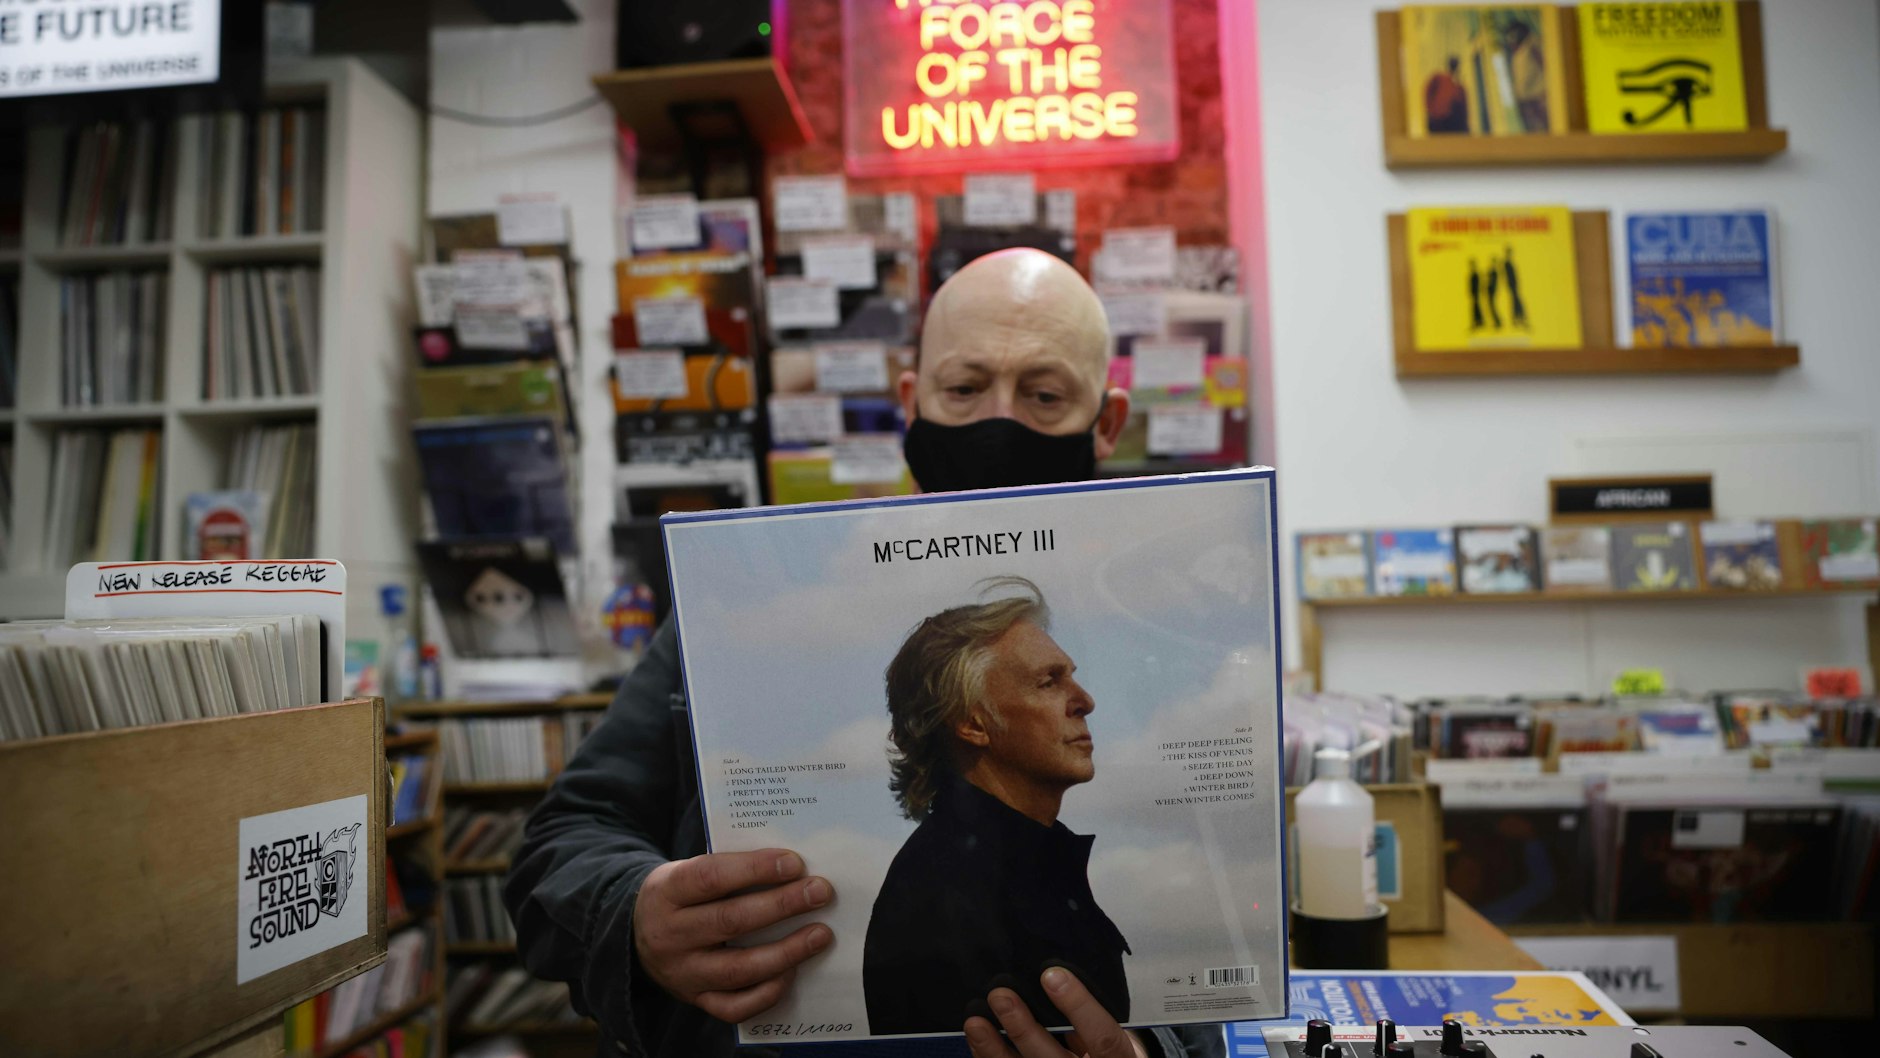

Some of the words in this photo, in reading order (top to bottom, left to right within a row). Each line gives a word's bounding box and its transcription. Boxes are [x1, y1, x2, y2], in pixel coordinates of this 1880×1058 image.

[1593, 2, 1722, 24] FREEDOM
[34, 2, 192, 43] FUTURE
[920, 0, 1095, 49] FORCE
[16, 64, 43, 86] OF
[52, 61, 89, 82] THE
[97, 55, 199, 80] UNIVERSE
[915, 50, 990, 97] OF
[996, 44, 1102, 94] THE
[881, 91, 1138, 149] UNIVERSE
[1632, 214, 1762, 250] CUBA
[1595, 486, 1672, 508] AFRICAN
[1033, 529, 1055, 551] III
[98, 572, 141, 592] NEW
[151, 565, 232, 588] RELEASE
[245, 564, 326, 583] REGGAE
[1162, 742, 1186, 750] DEEP
[1188, 740, 1212, 748] DEEP
[1213, 737, 1253, 746] FEELING
[1167, 753, 1186, 761] THE
[1188, 752, 1208, 760] KISS
[1209, 750, 1222, 758] OF
[1222, 748, 1253, 757] VENUS
[755, 766, 787, 774] TAILED
[788, 764, 824, 772] WINTER
[825, 762, 846, 770] BIRD
[1188, 762, 1214, 771] SEIZE
[1216, 760, 1234, 769] THE
[1236, 759, 1254, 767] DAY
[768, 776, 787, 784] WAY
[1200, 772, 1224, 781] DEEP
[1225, 770, 1254, 780] DOWN
[733, 788, 766, 796] PRETTY
[1189, 784, 1226, 792] WINTER
[1227, 782, 1249, 790] BIRD
[734, 800, 769, 808] WOMEN
[770, 798, 788, 806] AND
[789, 796, 818, 804] WIVES
[1154, 798, 1184, 806] WHEN
[1184, 795, 1222, 804] WINTER
[1222, 792, 1255, 802] COMES
[736, 810, 780, 818] LAVATORY
[780, 808, 794, 816] LIL
[737, 820, 768, 829] SLIDIN'
[245, 832, 321, 880] NORTH
[250, 898, 321, 949] SOUND
[1320, 979, 1358, 1026] EVOLUTION
[1477, 1029, 1587, 1037] Numark
